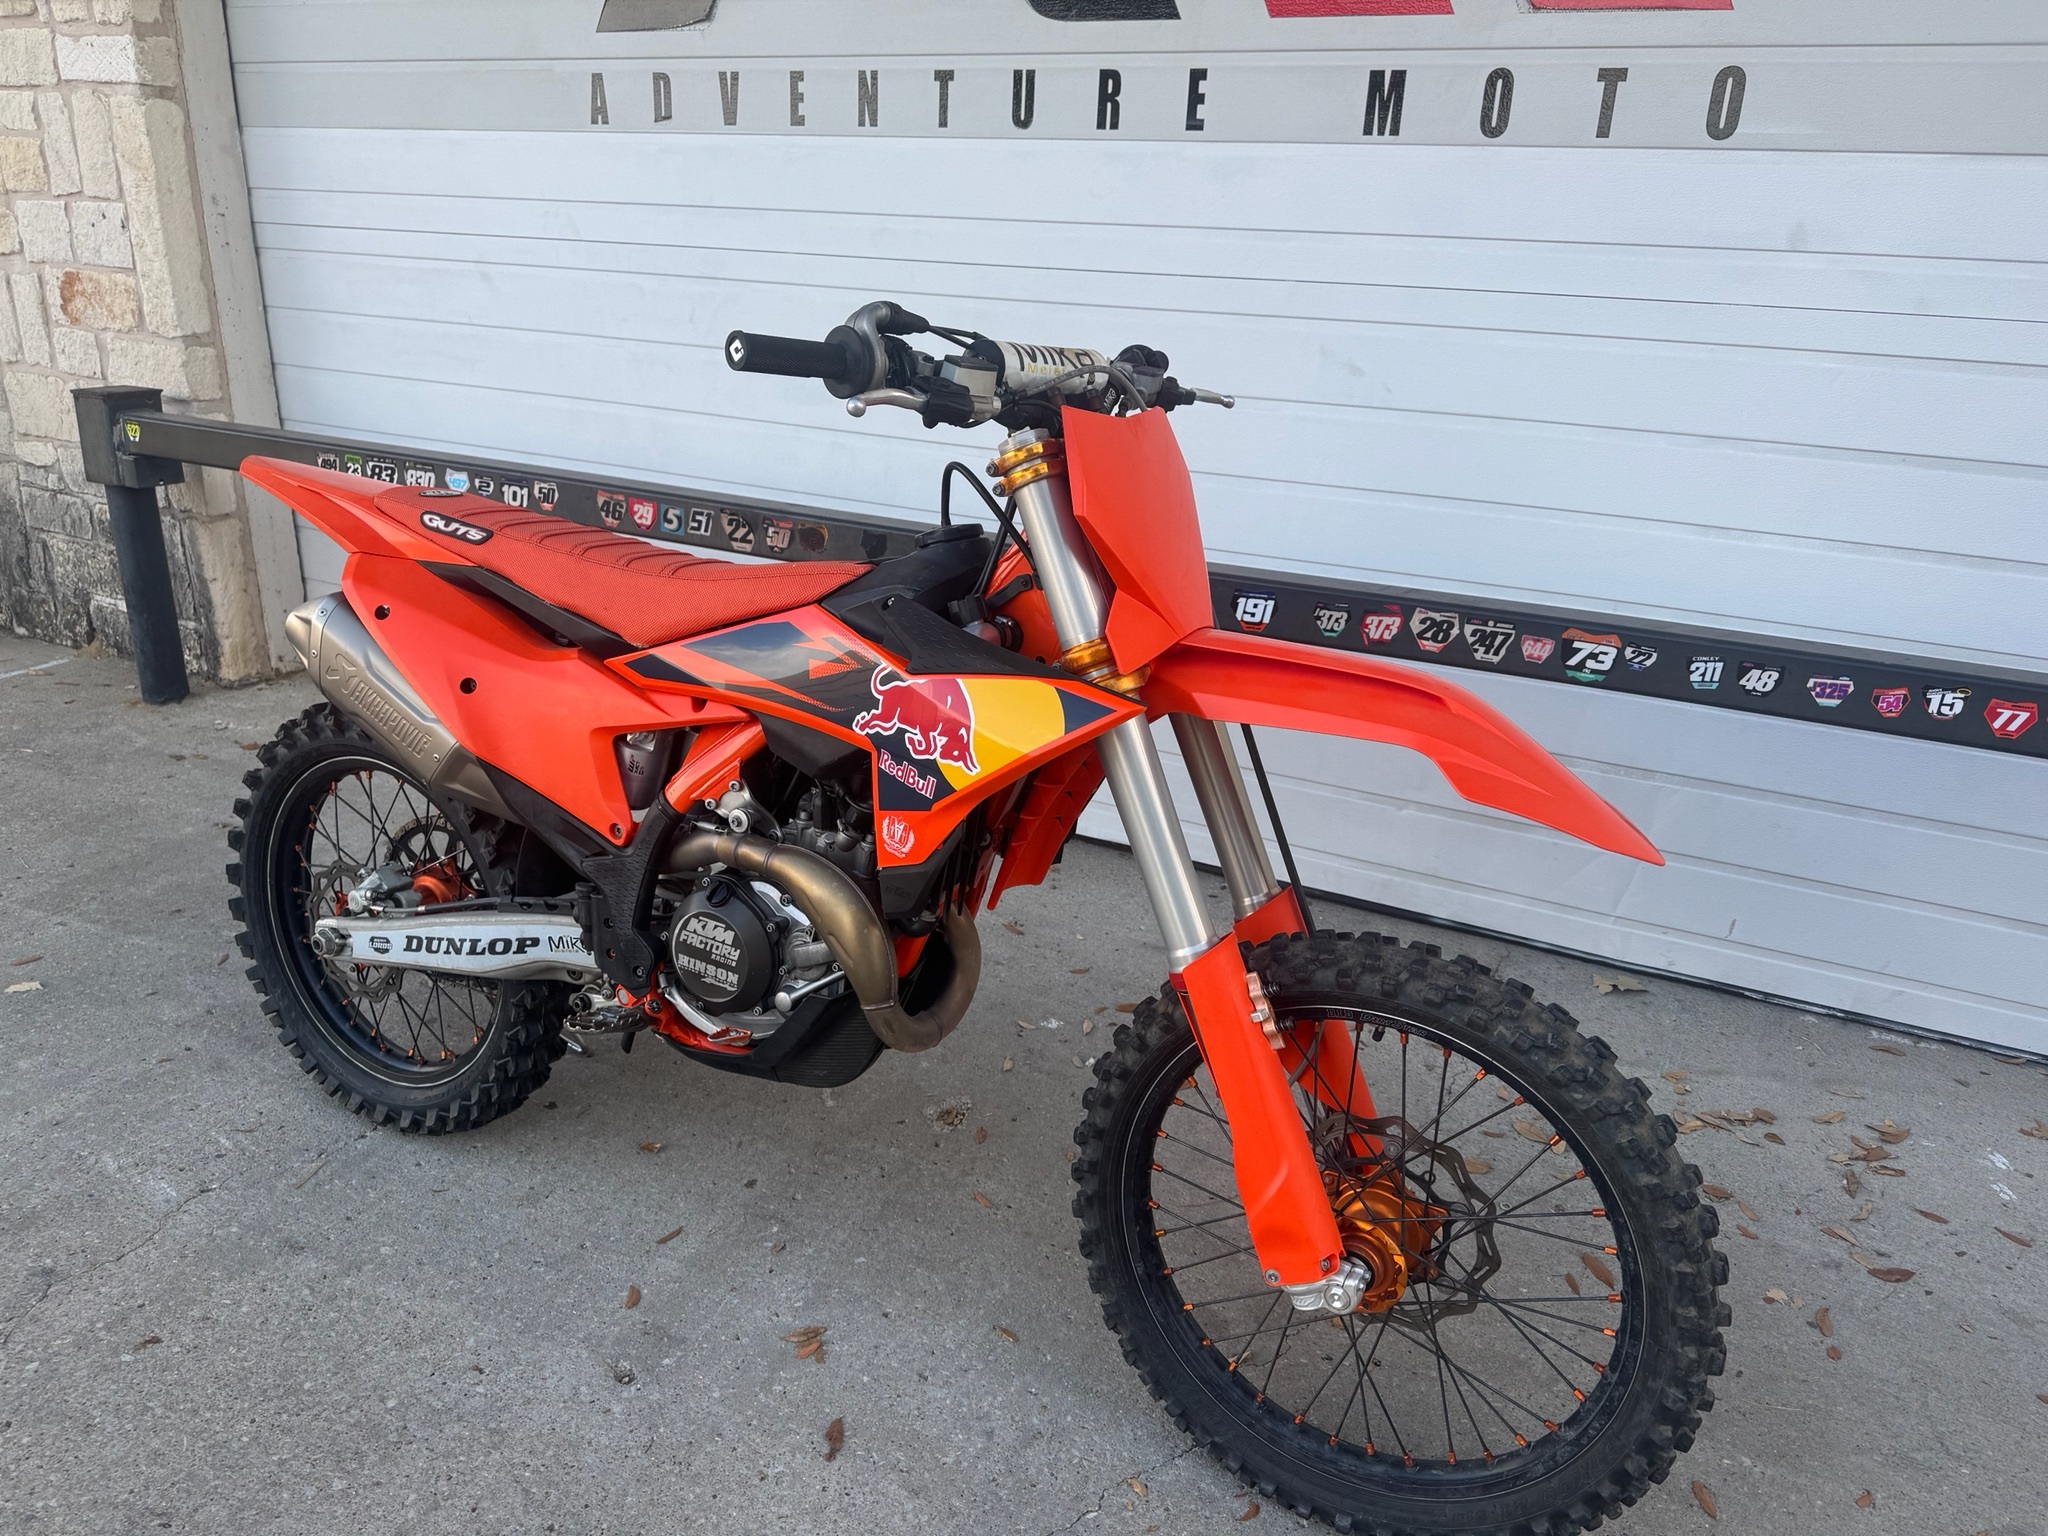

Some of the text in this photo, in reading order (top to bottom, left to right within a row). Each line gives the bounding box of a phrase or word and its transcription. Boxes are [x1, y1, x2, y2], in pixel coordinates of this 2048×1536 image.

[590, 65, 1747, 141] ADVENTURE MOTO
[369, 463, 396, 484] 83
[478, 480, 492, 493] 2
[501, 484, 529, 508] 101
[538, 486, 556, 505] 50
[600, 499, 625, 521] 46
[633, 503, 654, 525] 29
[664, 508, 681, 531] 5
[689, 509, 713, 534] 51
[422, 513, 487, 541] GUTS
[726, 517, 753, 545] 22
[766, 526, 791, 548] 50
[1235, 597, 1276, 624] 191
[1364, 615, 1402, 640] 373
[1415, 616, 1455, 645] 28
[1469, 627, 1514, 657] 247
[1564, 640, 1618, 671] 73
[1689, 661, 1724, 682] 211
[1738, 668, 1780, 692] 48
[1878, 694, 1904, 712] 54
[1926, 693, 1965, 715] 15
[1992, 708, 2031, 732] 77
[685, 915, 736, 946] KTM
[402, 934, 541, 956] DUNLOP
[679, 929, 741, 961] FACTORY
[677, 953, 740, 985] HINSON
